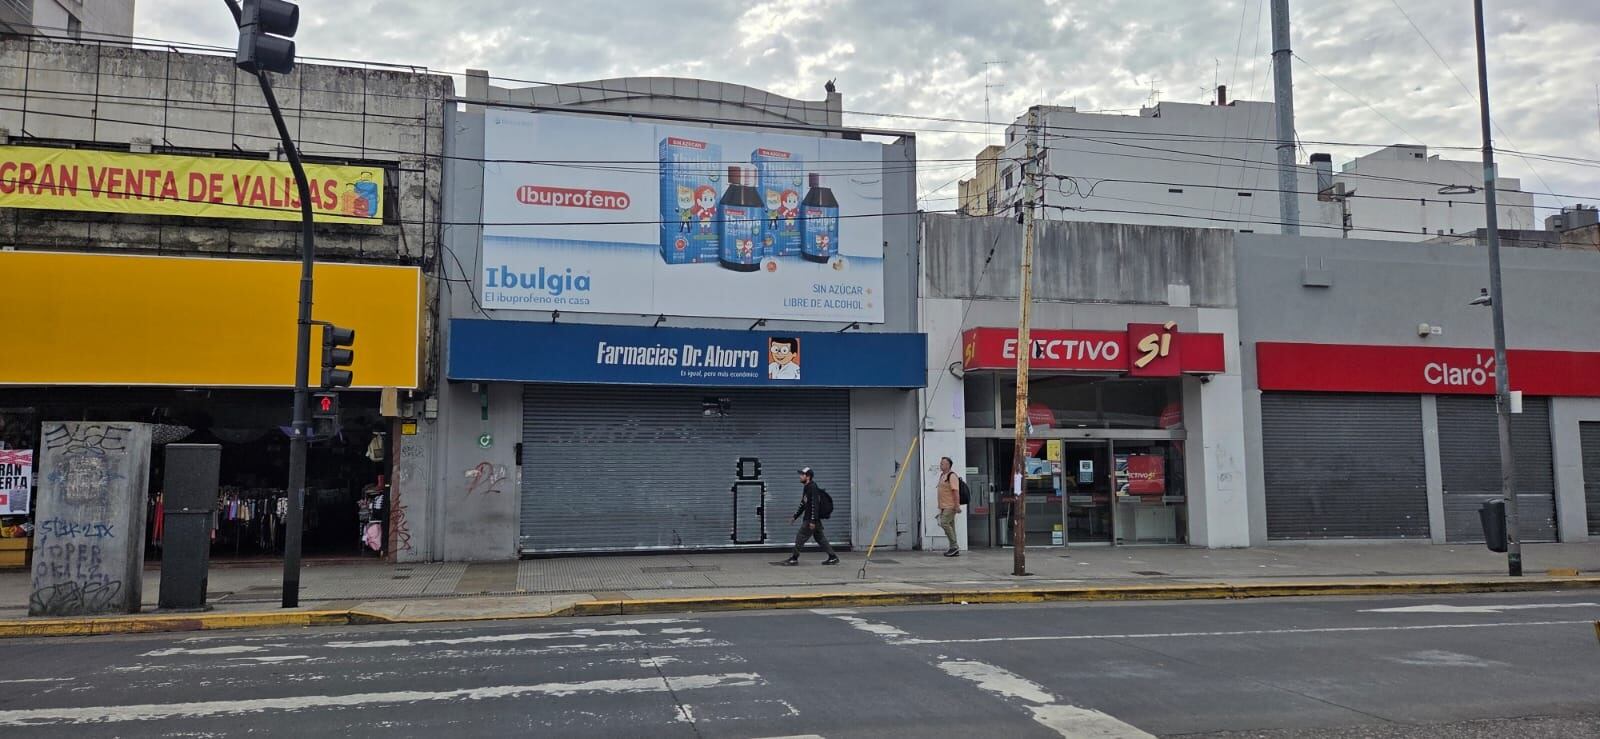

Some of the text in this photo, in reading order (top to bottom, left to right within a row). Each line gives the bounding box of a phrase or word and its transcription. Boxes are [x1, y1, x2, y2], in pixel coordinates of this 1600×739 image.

[0, 161, 79, 197] GRAN
[87, 166, 180, 202] VENTA
[188, 172, 224, 203] DE
[520, 186, 628, 208] Ibuprofeno
[486, 265, 590, 296] Ibulgia
[813, 283, 863, 295] SIN AZÚCAR
[485, 292, 494, 302] El
[497, 292, 552, 305] ibuprofeno
[569, 297, 590, 305] casa
[784, 297, 863, 310] LIBRE DE ALCOHOL
[597, 341, 677, 367] Farmacias
[1002, 338, 1120, 361] EECTIVO
[1424, 362, 1487, 386] Claro
